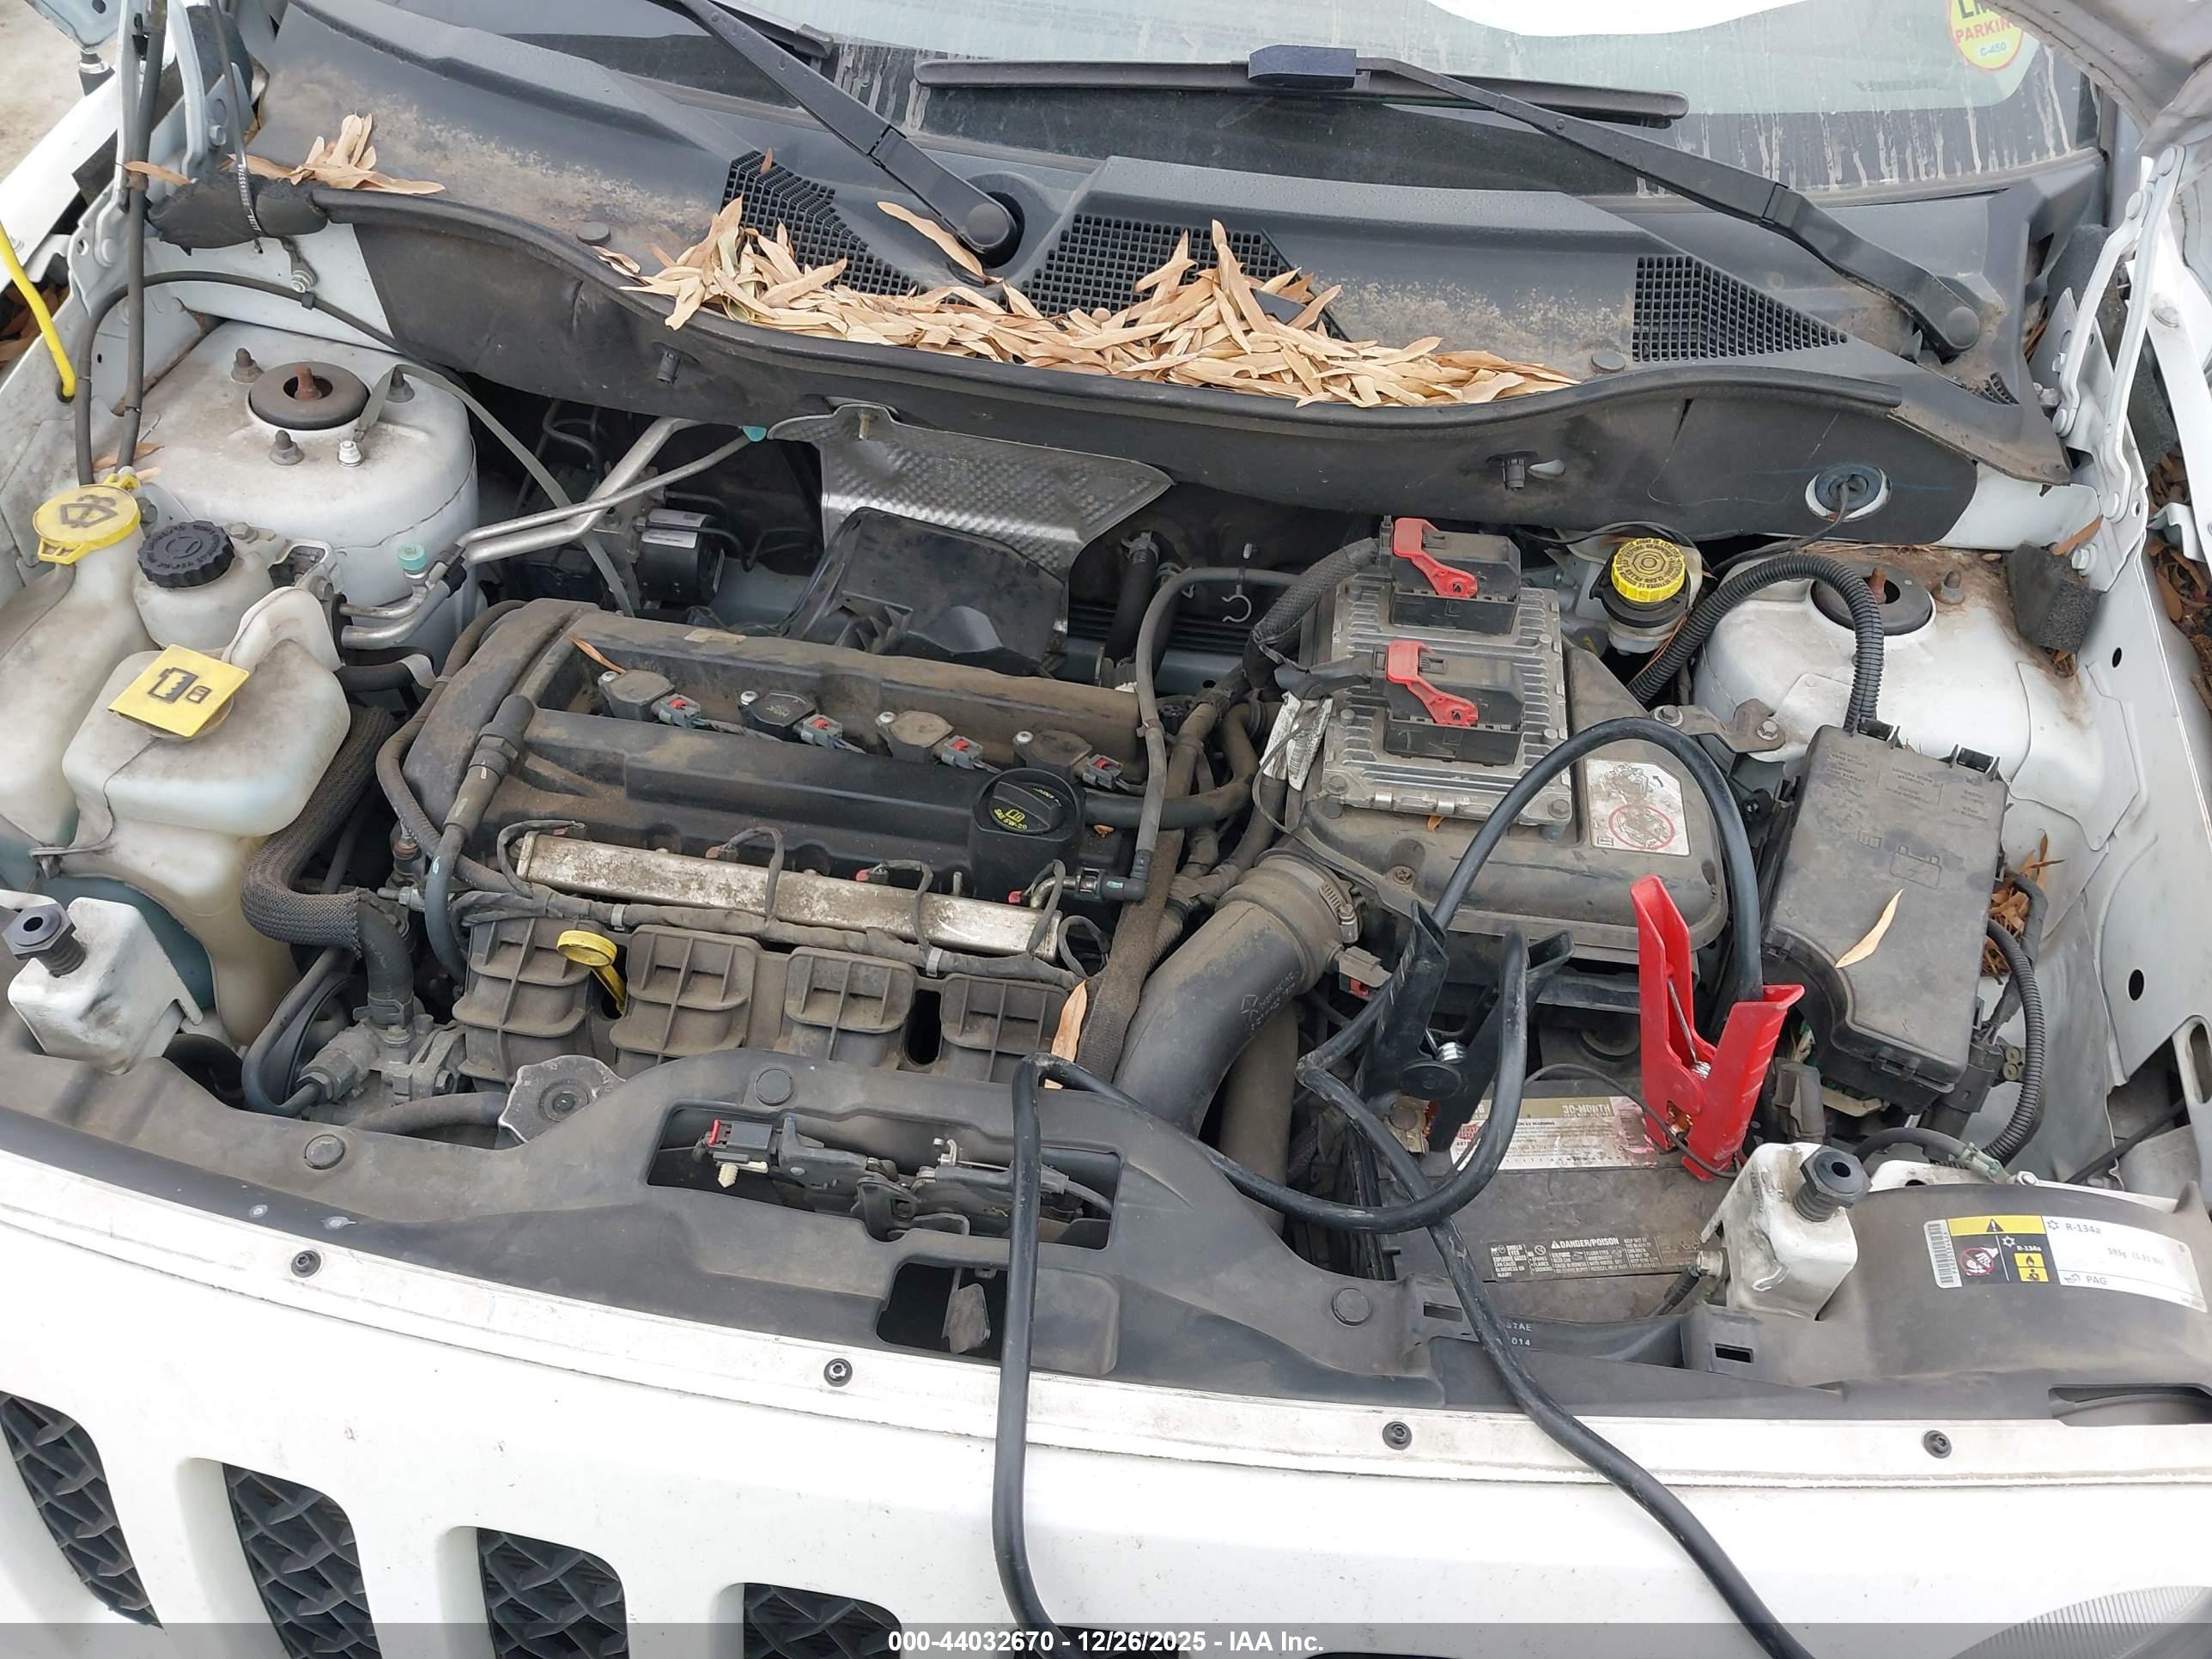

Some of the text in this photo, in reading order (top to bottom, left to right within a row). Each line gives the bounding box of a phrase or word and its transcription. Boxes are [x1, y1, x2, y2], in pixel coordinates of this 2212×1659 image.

[2065, 1222, 2101, 1235] R-134a
[1559, 1237, 1620, 1249] DANGER/POISON
[2086, 1275, 2108, 1285] PAG
